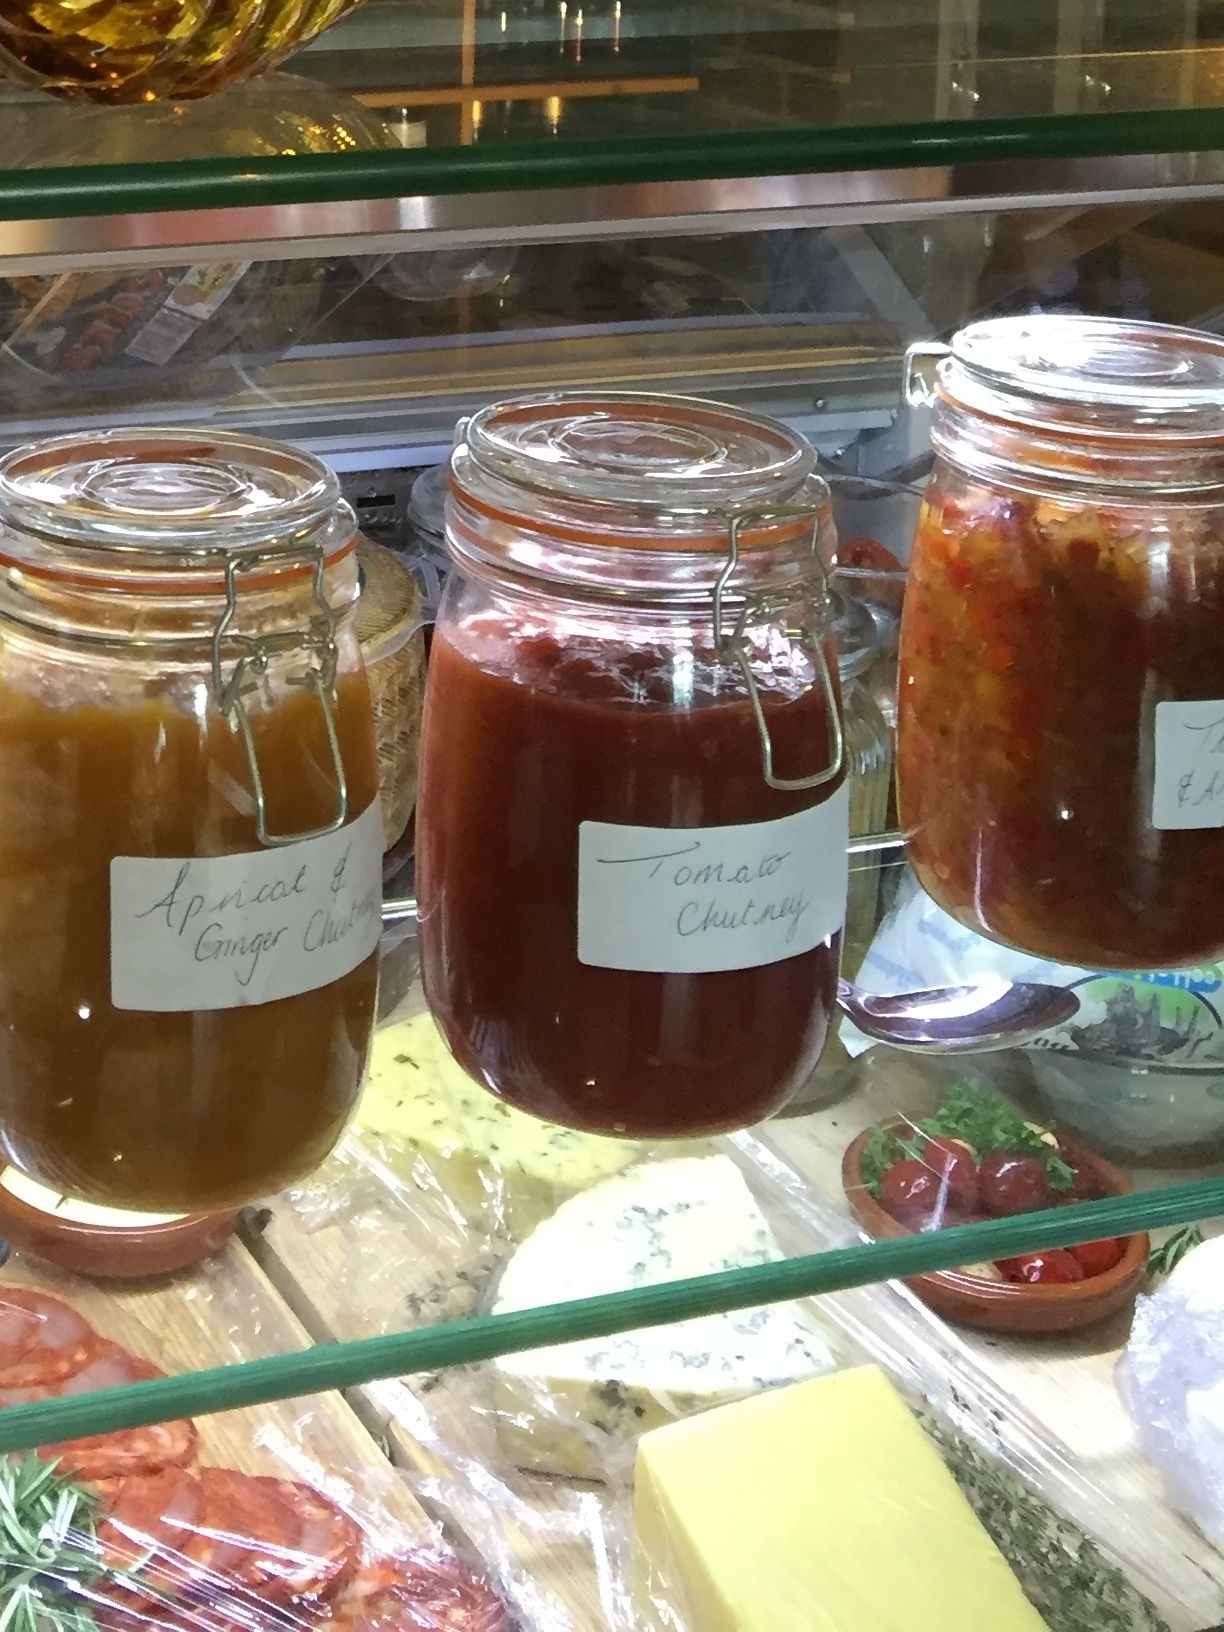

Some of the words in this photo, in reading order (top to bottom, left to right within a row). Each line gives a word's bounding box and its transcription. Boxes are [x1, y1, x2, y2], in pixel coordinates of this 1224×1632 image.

[596, 840, 792, 887] Tomato
[135, 861, 307, 936] Apricot
[676, 889, 812, 944] Chutney
[194, 922, 289, 986] Ginger
